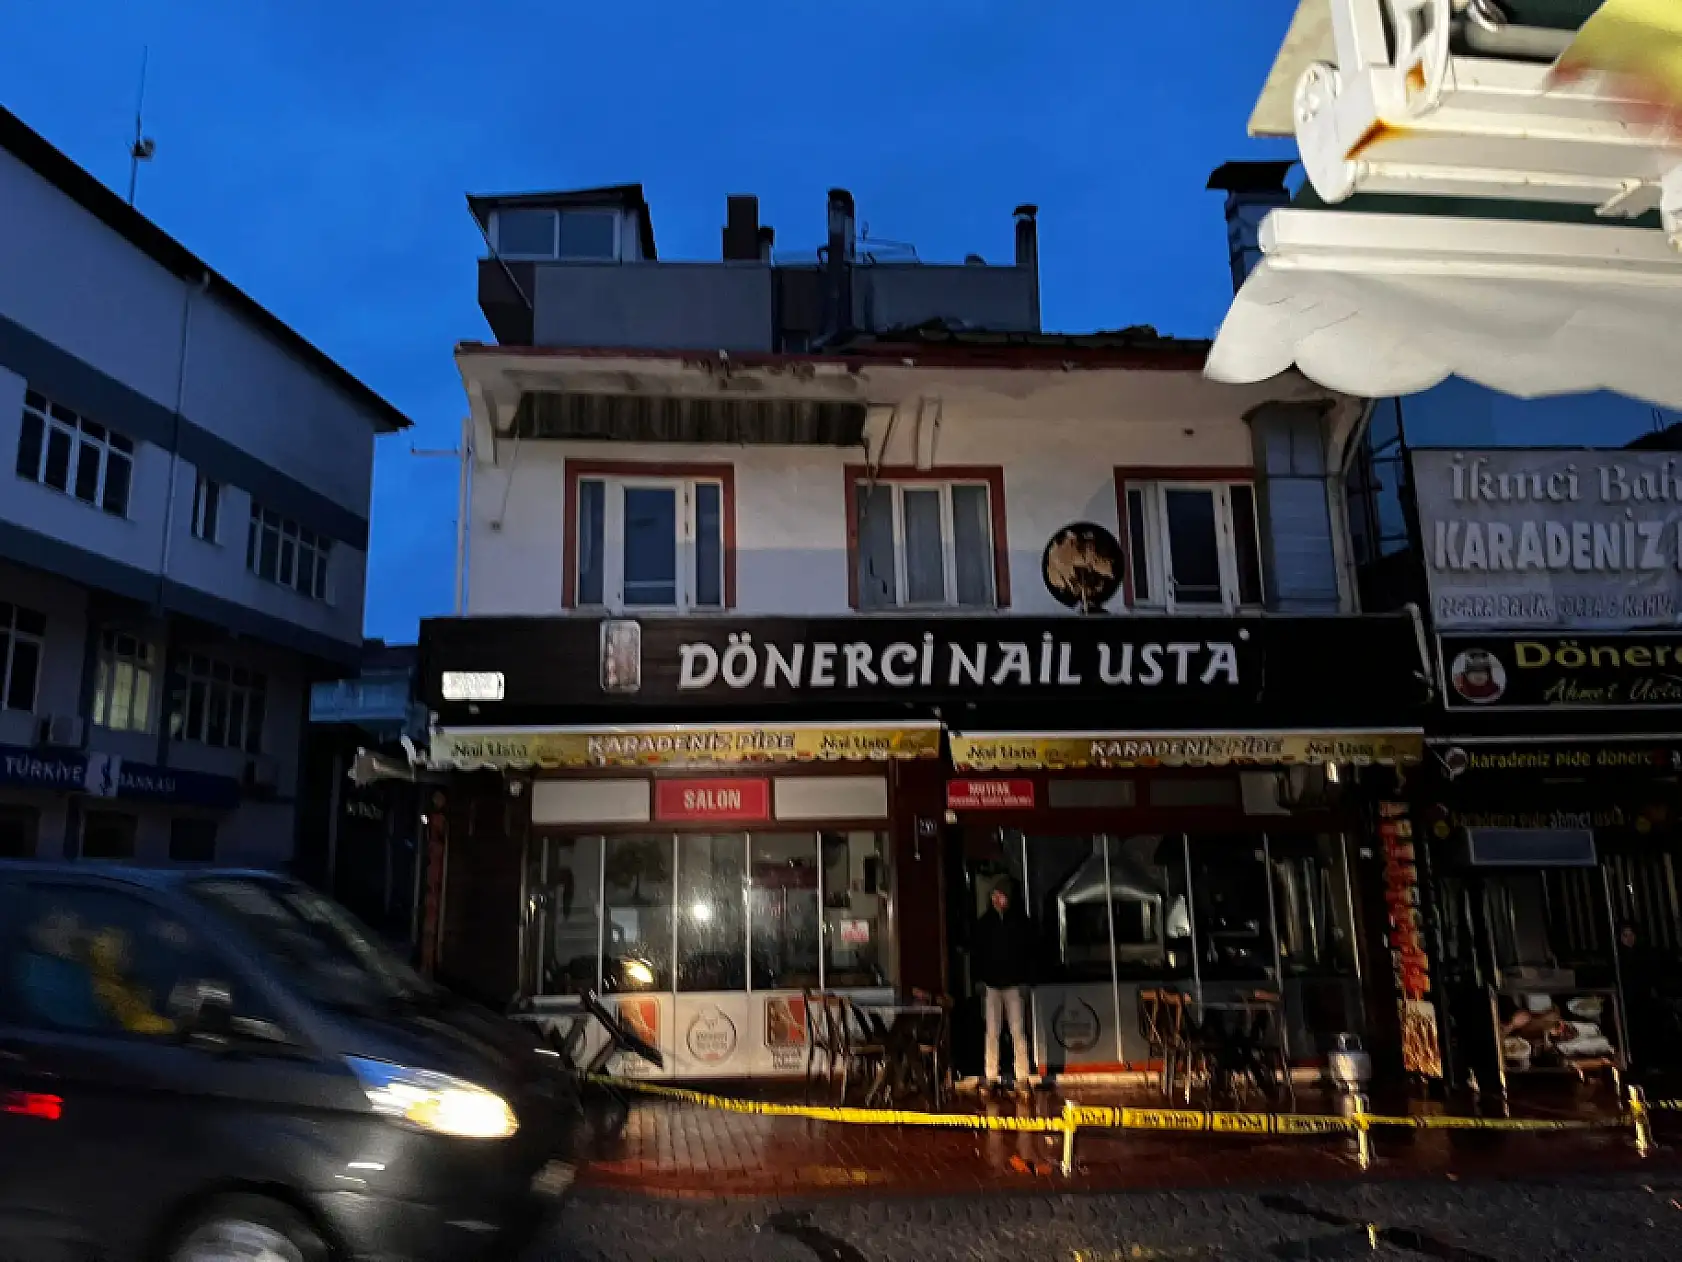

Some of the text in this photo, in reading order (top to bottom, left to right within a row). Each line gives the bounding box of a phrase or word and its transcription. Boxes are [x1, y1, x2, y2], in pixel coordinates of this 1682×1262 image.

[1434, 507, 1666, 571] KARADENİZ
[677, 630, 1240, 690] DÖNERCİ NAİL USTA
[5, 753, 84, 783] TÜRKİYE
[683, 788, 741, 810] SALON
